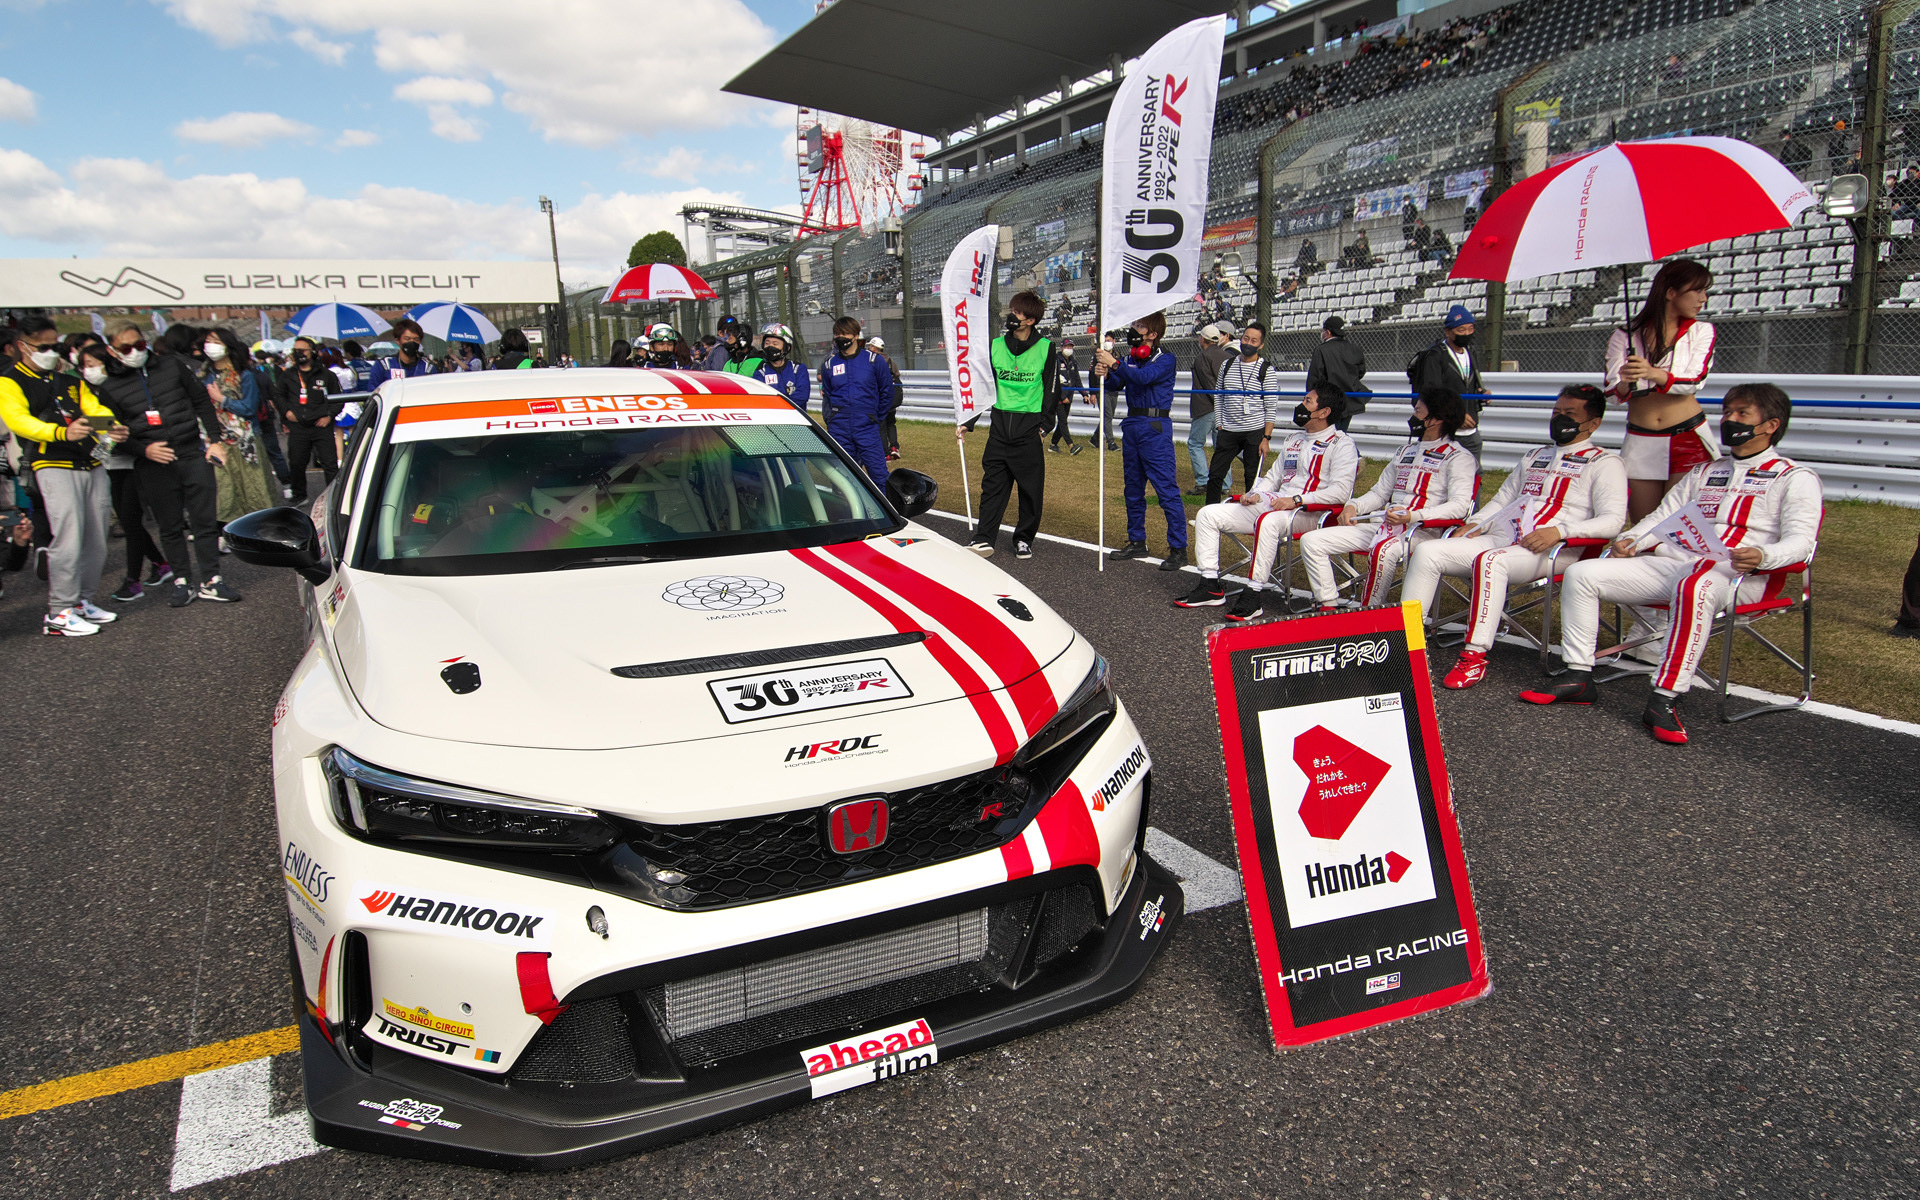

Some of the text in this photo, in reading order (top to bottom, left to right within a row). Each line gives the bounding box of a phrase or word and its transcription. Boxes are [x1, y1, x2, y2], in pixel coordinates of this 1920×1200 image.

[1137, 75, 1160, 202] ANNIVERSARY
[1161, 73, 1189, 201] TYPE R
[1574, 165, 1599, 260] Honda RACING
[203, 274, 481, 289] SUZUKA CIRCUIT
[955, 298, 974, 412] HONDA
[1010, 370, 1036, 378] Super
[561, 395, 689, 412] ENEOS
[485, 412, 753, 430] Honda RACING
[1523, 483, 1542, 491] NGK
[1679, 514, 1714, 553] HOND
[705, 608, 787, 621] IMAGINATION
[1480, 581, 1491, 624] Honda
[1684, 579, 1713, 671] Honda RACING
[1251, 643, 1337, 681] Tarmac
[799, 670, 883, 688] ANNIVERSARY
[805, 677, 892, 698] TYPE R
[783, 733, 883, 762] HRDC
[979, 802, 1003, 821] R
[283, 841, 336, 903] ENDLESS
[1305, 853, 1387, 899] Honda
[1277, 929, 1469, 988] Honda RACING
[374, 1012, 471, 1056] TRUST
[386, 1004, 473, 1037] HERO SINOI CIRCUIT
[807, 1019, 934, 1077] ahead
[872, 1053, 932, 1082] film
[357, 1099, 388, 1111] MUGEN
[432, 1118, 463, 1130] POWER
